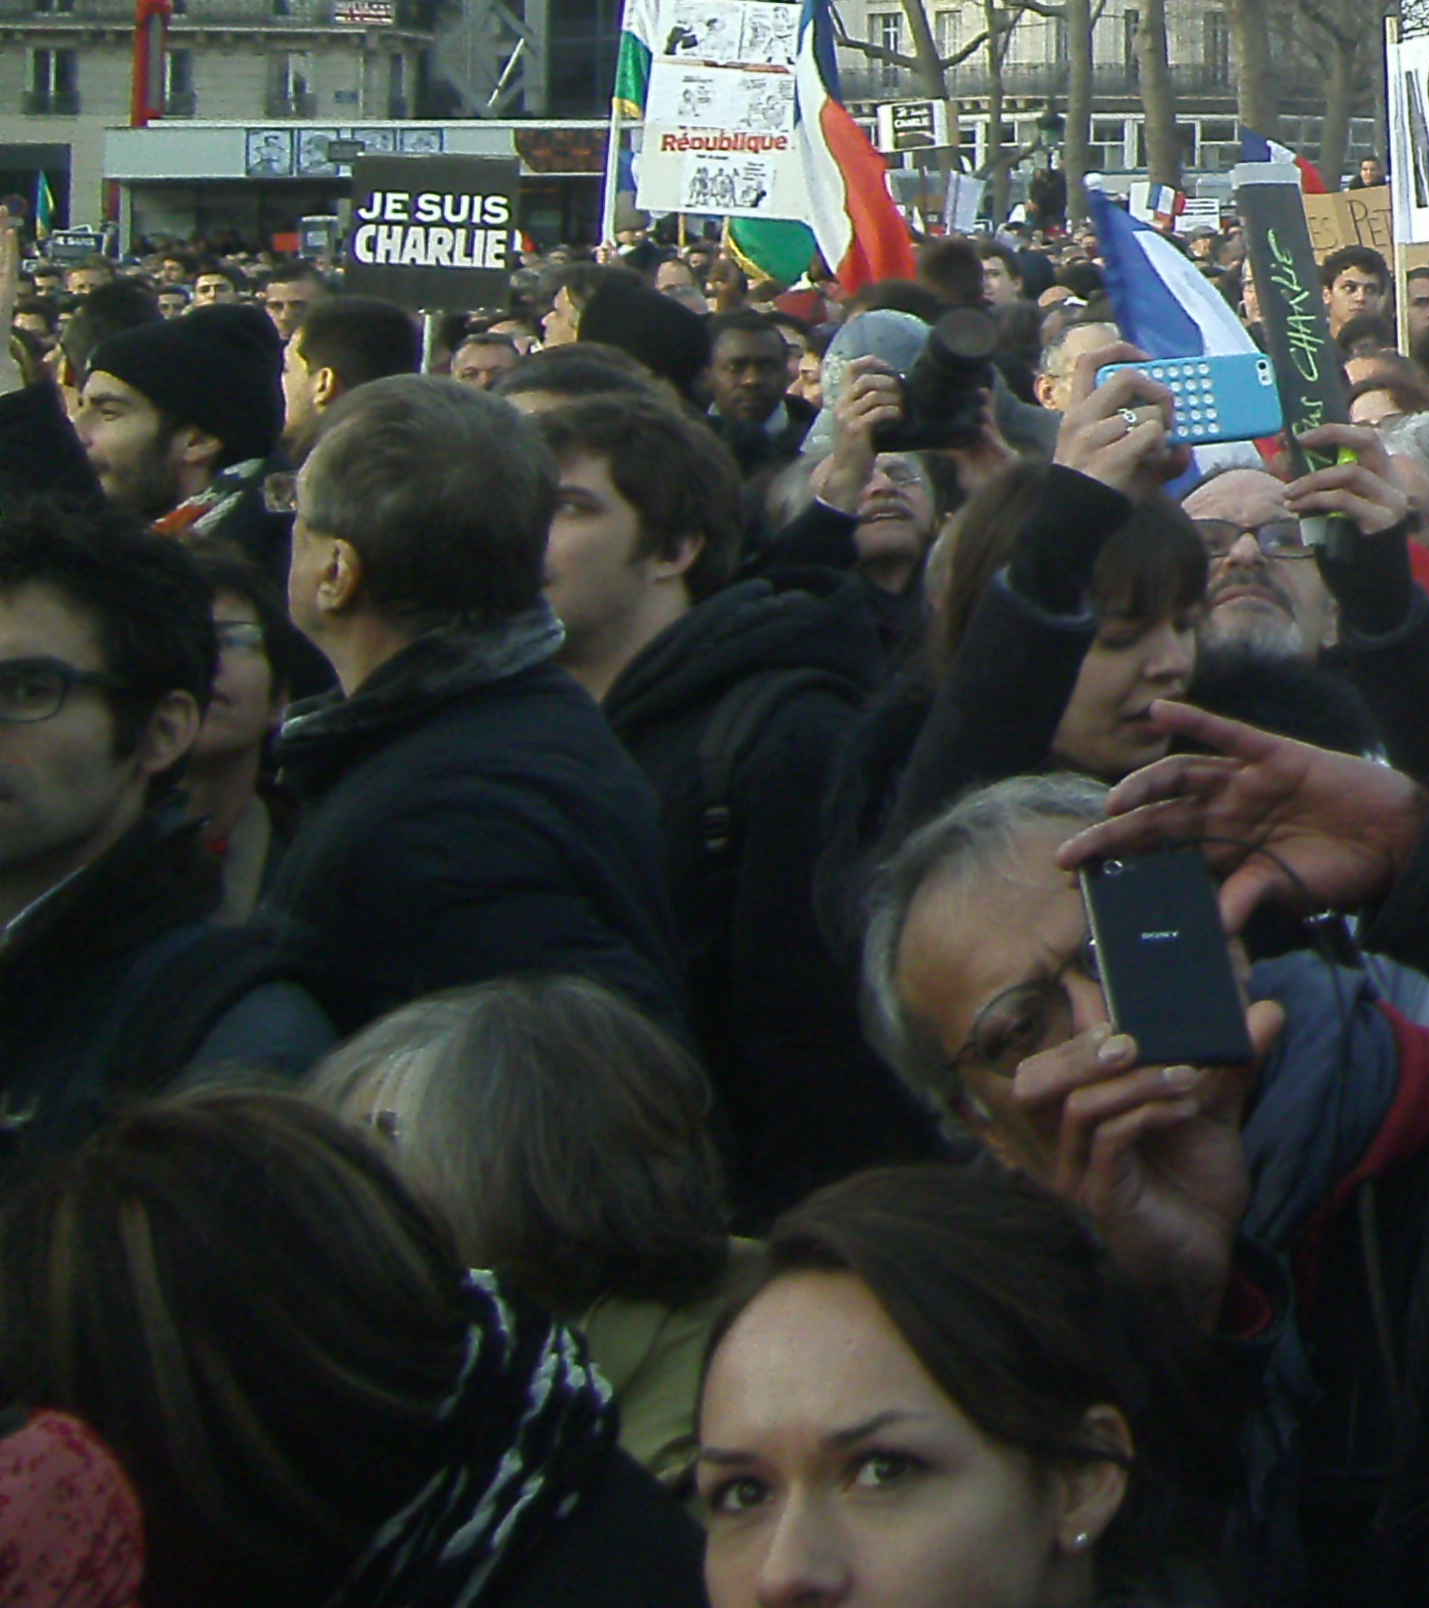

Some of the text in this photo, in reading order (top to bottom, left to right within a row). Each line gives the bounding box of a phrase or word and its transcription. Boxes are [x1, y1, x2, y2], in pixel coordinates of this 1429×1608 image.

[357, 191, 510, 225] JE SUIS
[354, 223, 508, 269] CHARLIE
